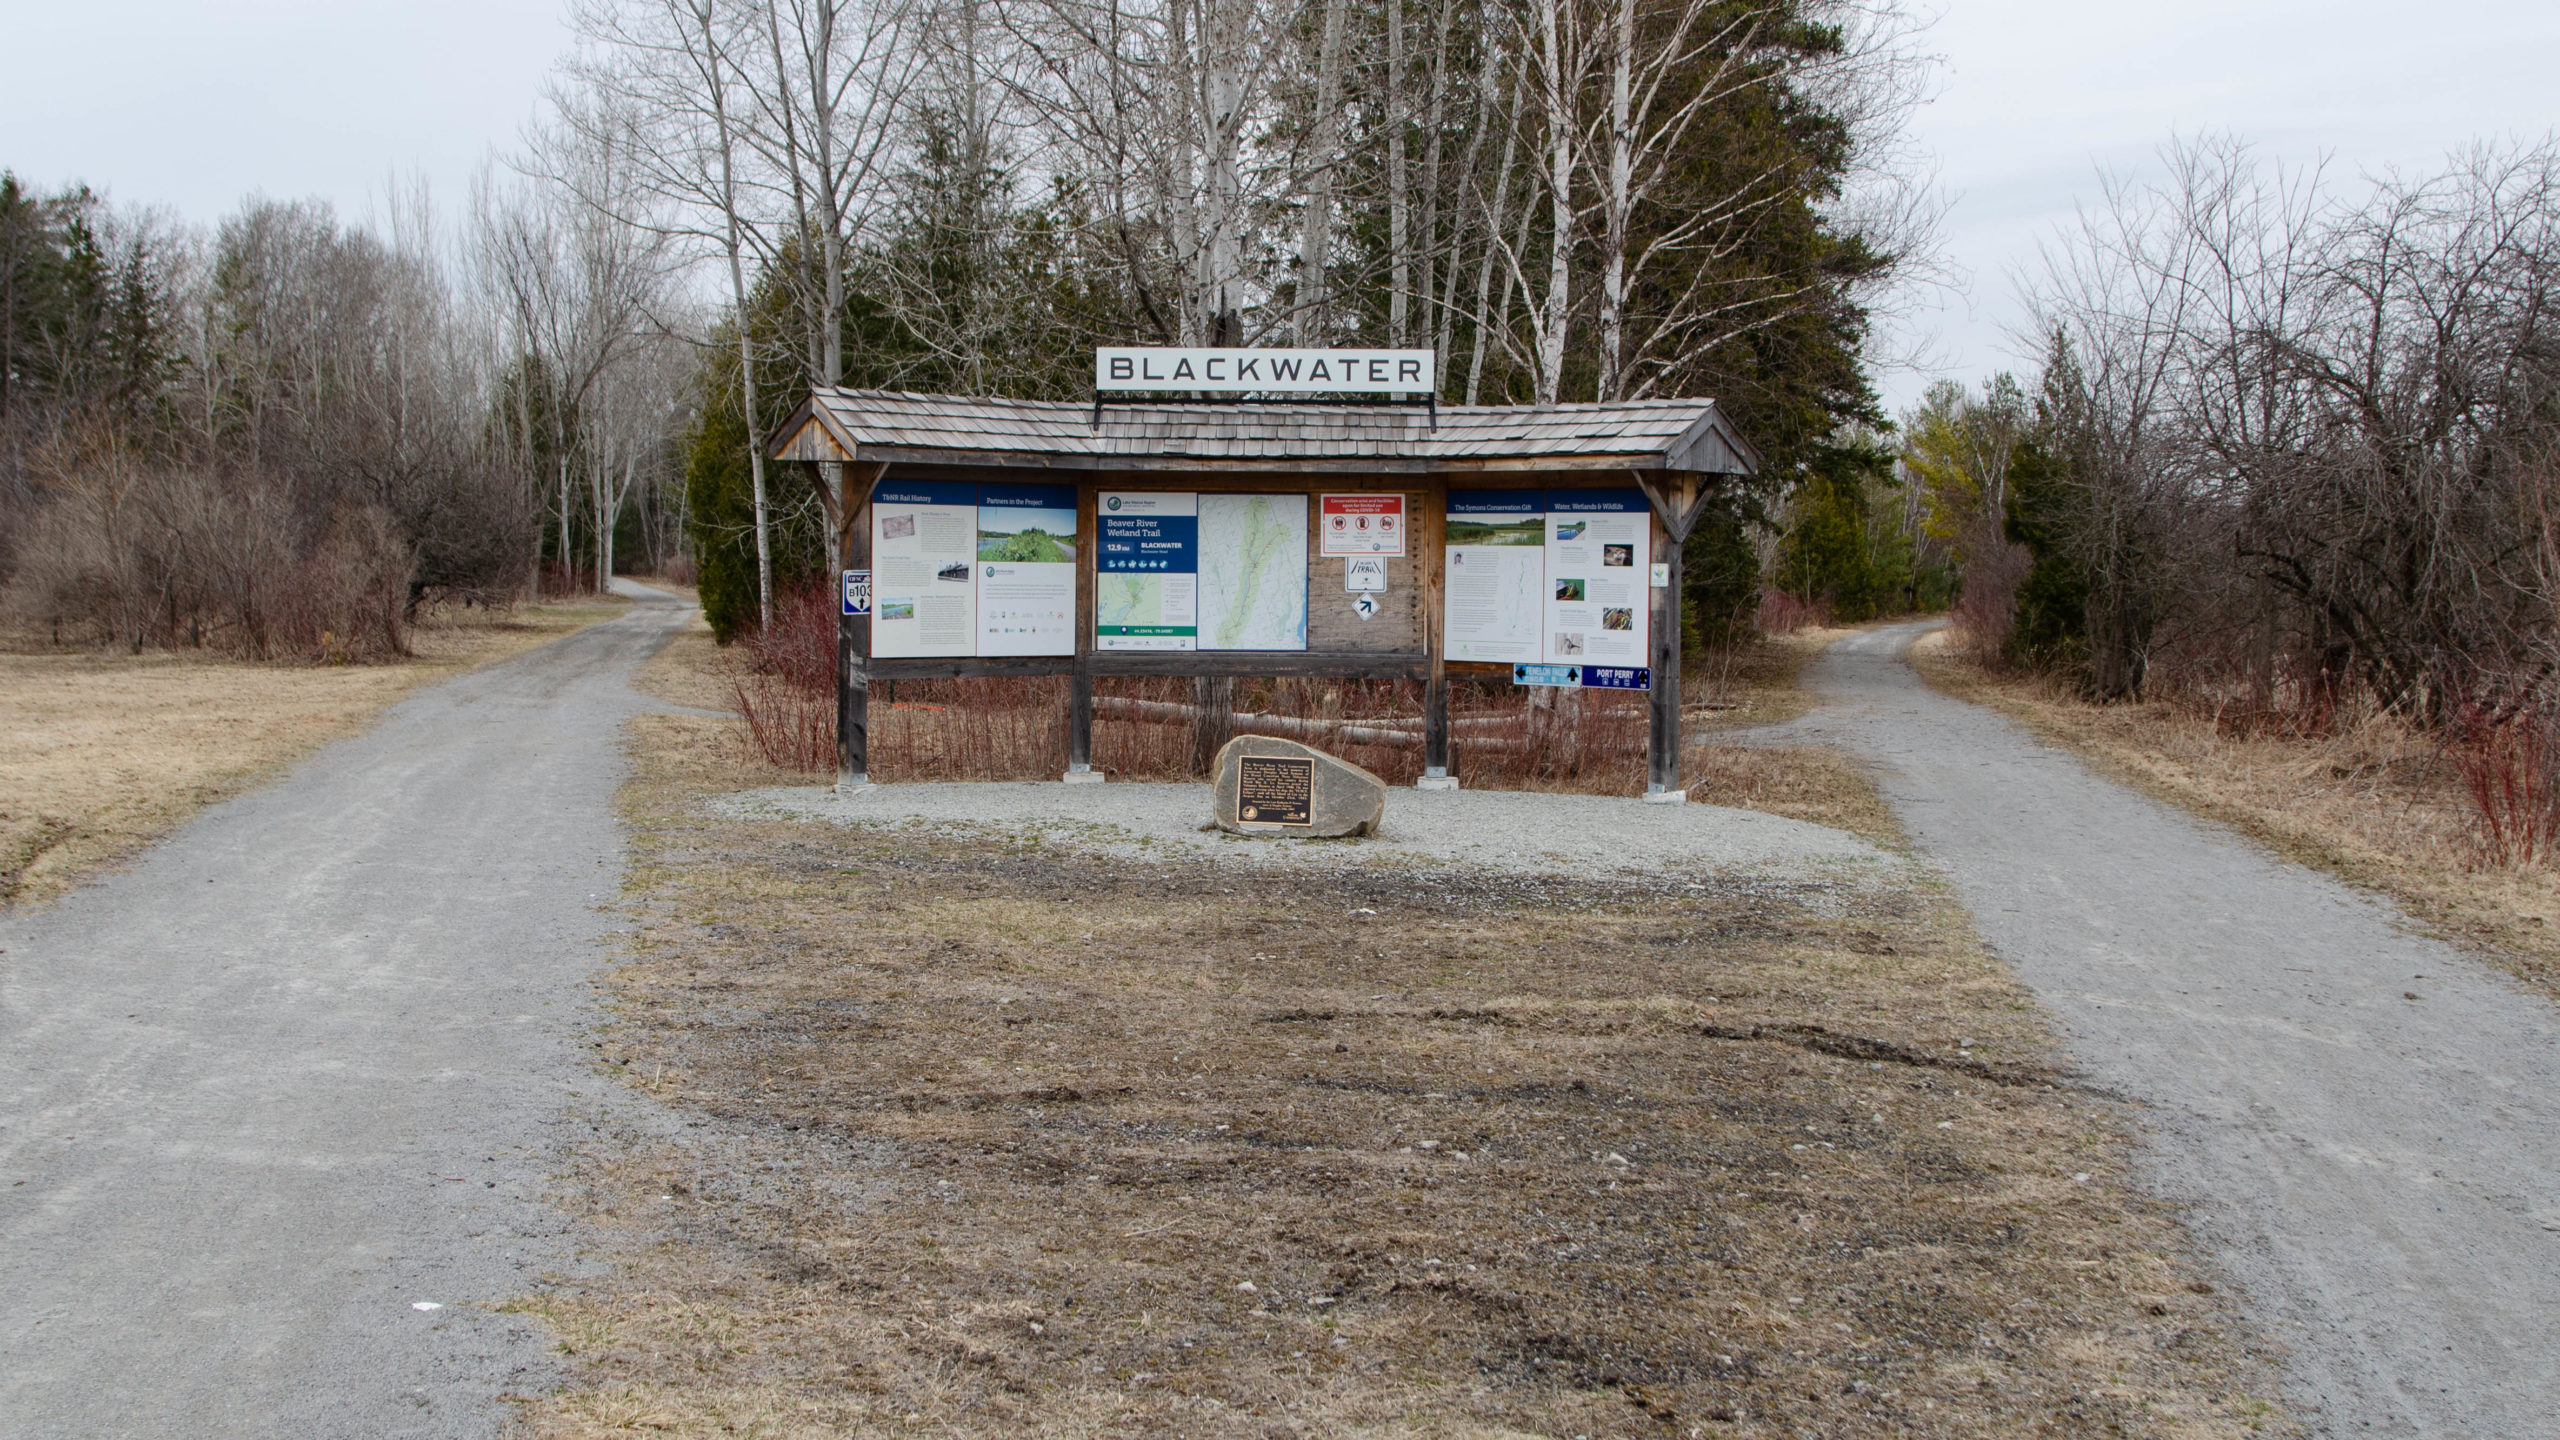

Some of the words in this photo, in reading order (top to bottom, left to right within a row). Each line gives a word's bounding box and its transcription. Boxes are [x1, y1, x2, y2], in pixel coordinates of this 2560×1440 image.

[1110, 357, 1421, 382] BLACKWATER
[911, 494, 931, 502] History
[1107, 519, 1134, 527] Beaver
[1136, 519, 1158, 527] River
[1107, 529, 1140, 537] Wetland
[1142, 529, 1161, 537] Trail
[1597, 669, 1613, 678] PORT
[1614, 670, 1634, 679] PERRY
